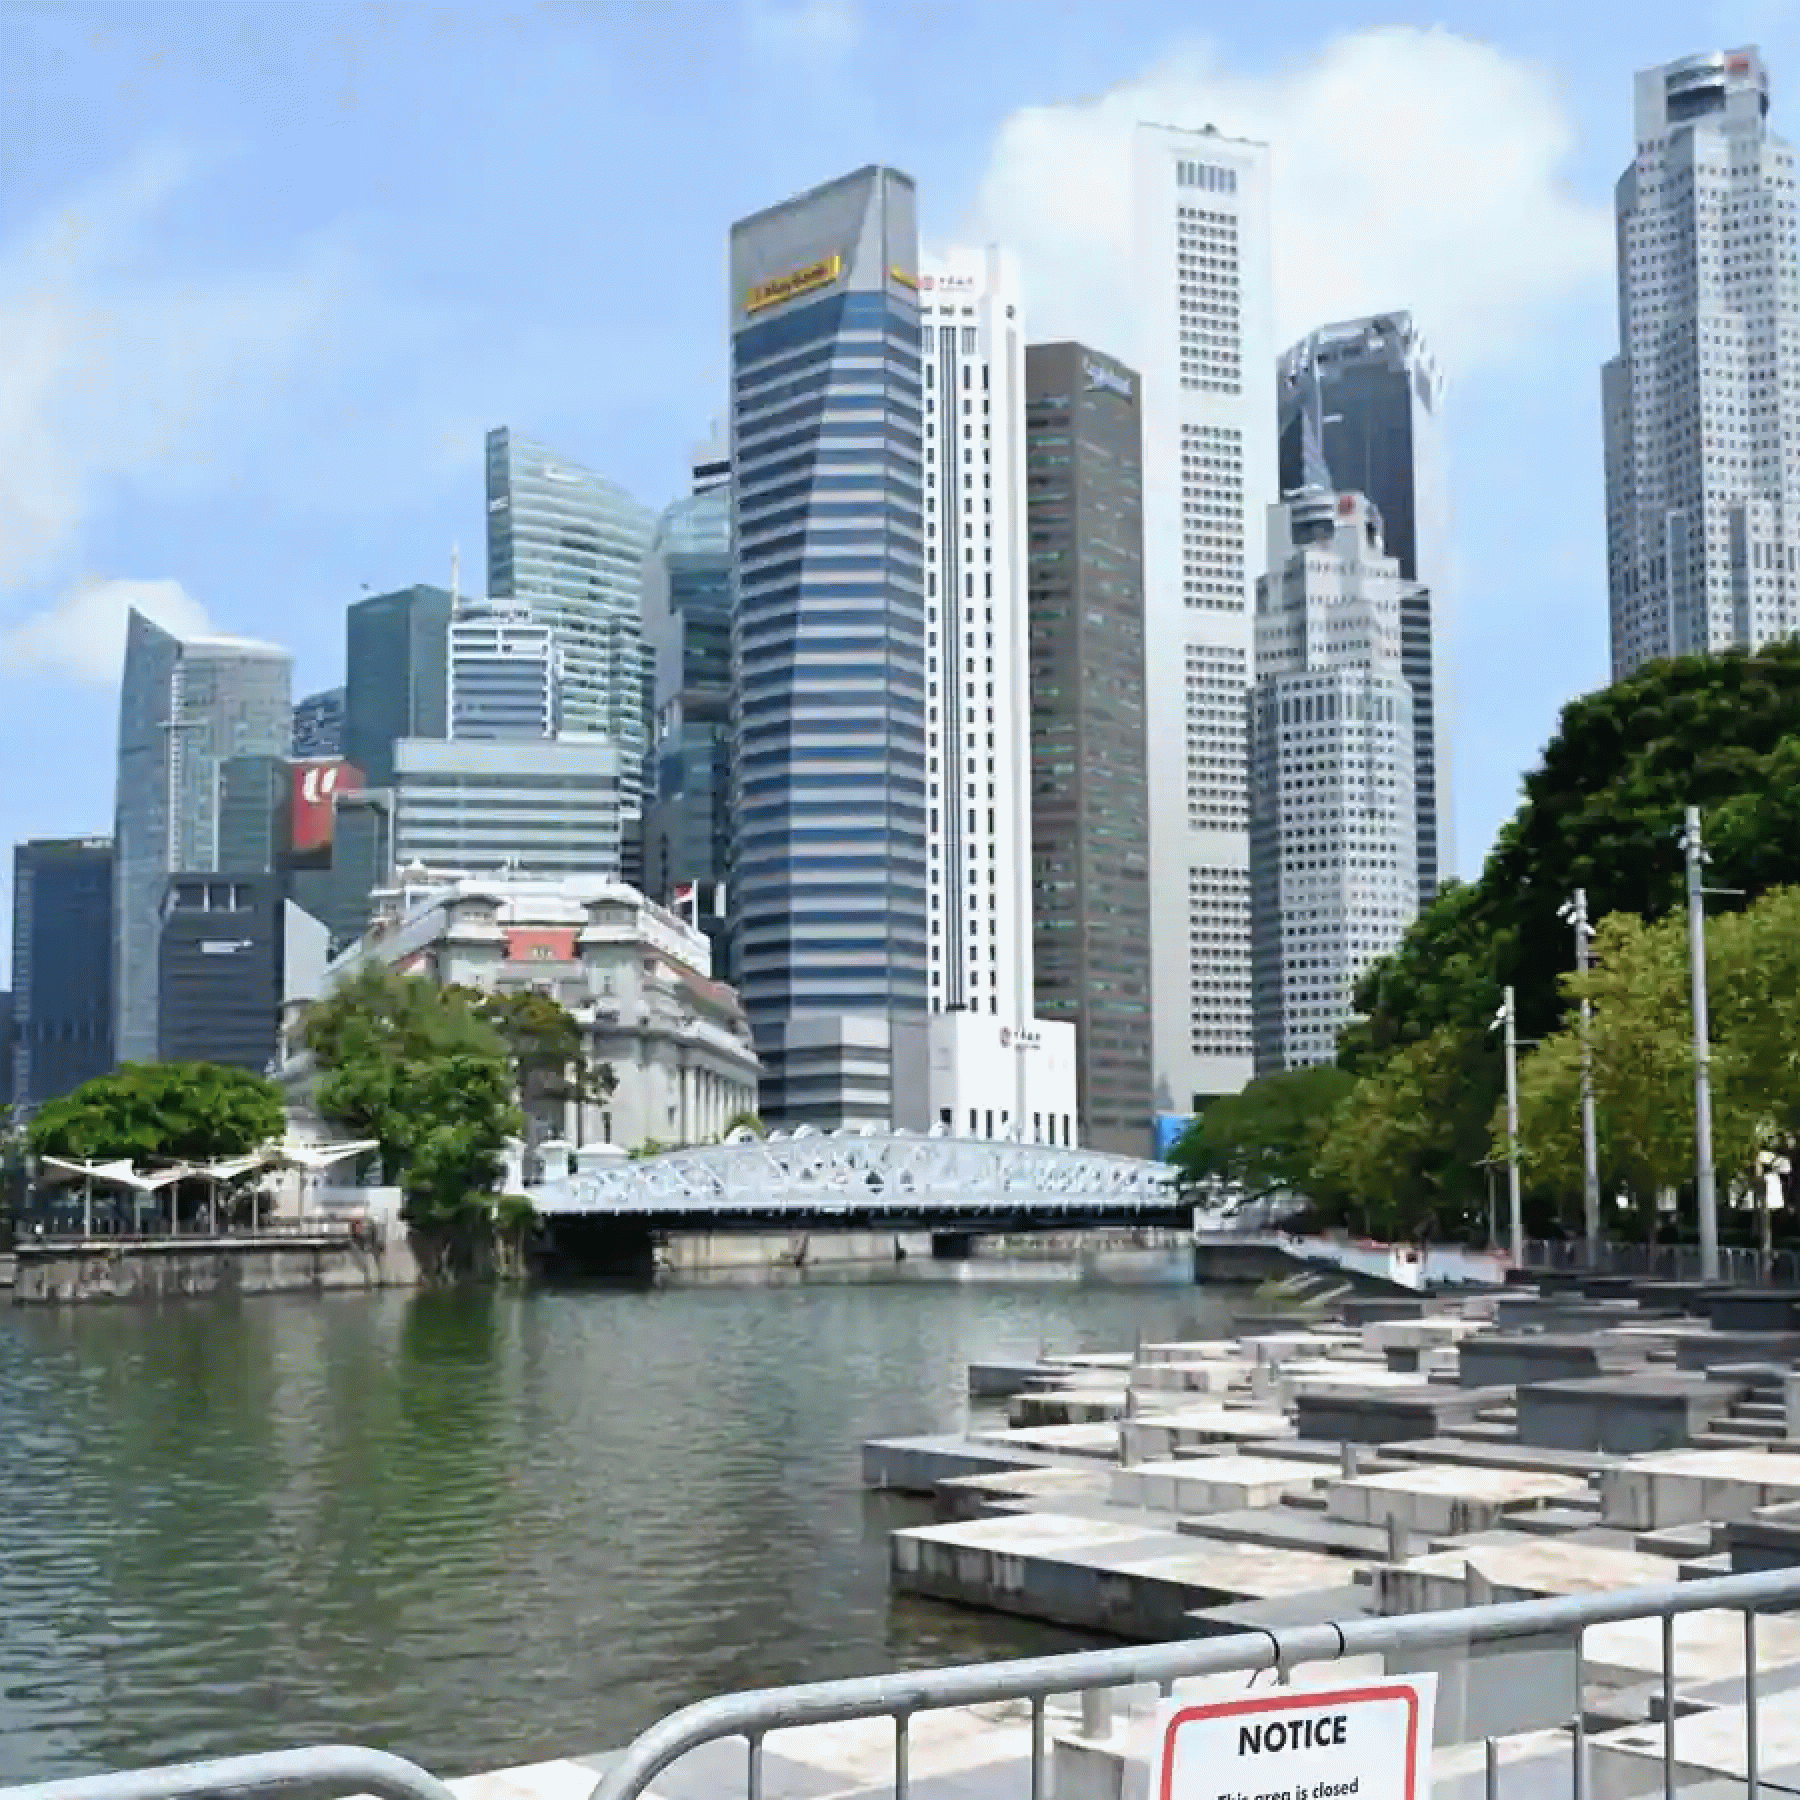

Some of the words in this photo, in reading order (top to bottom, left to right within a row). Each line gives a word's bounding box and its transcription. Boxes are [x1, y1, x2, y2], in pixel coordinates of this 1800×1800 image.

[1238, 1715, 1348, 1756] NOTICE
[1295, 1784, 1309, 1800] is
[1312, 1775, 1359, 1799] closed
